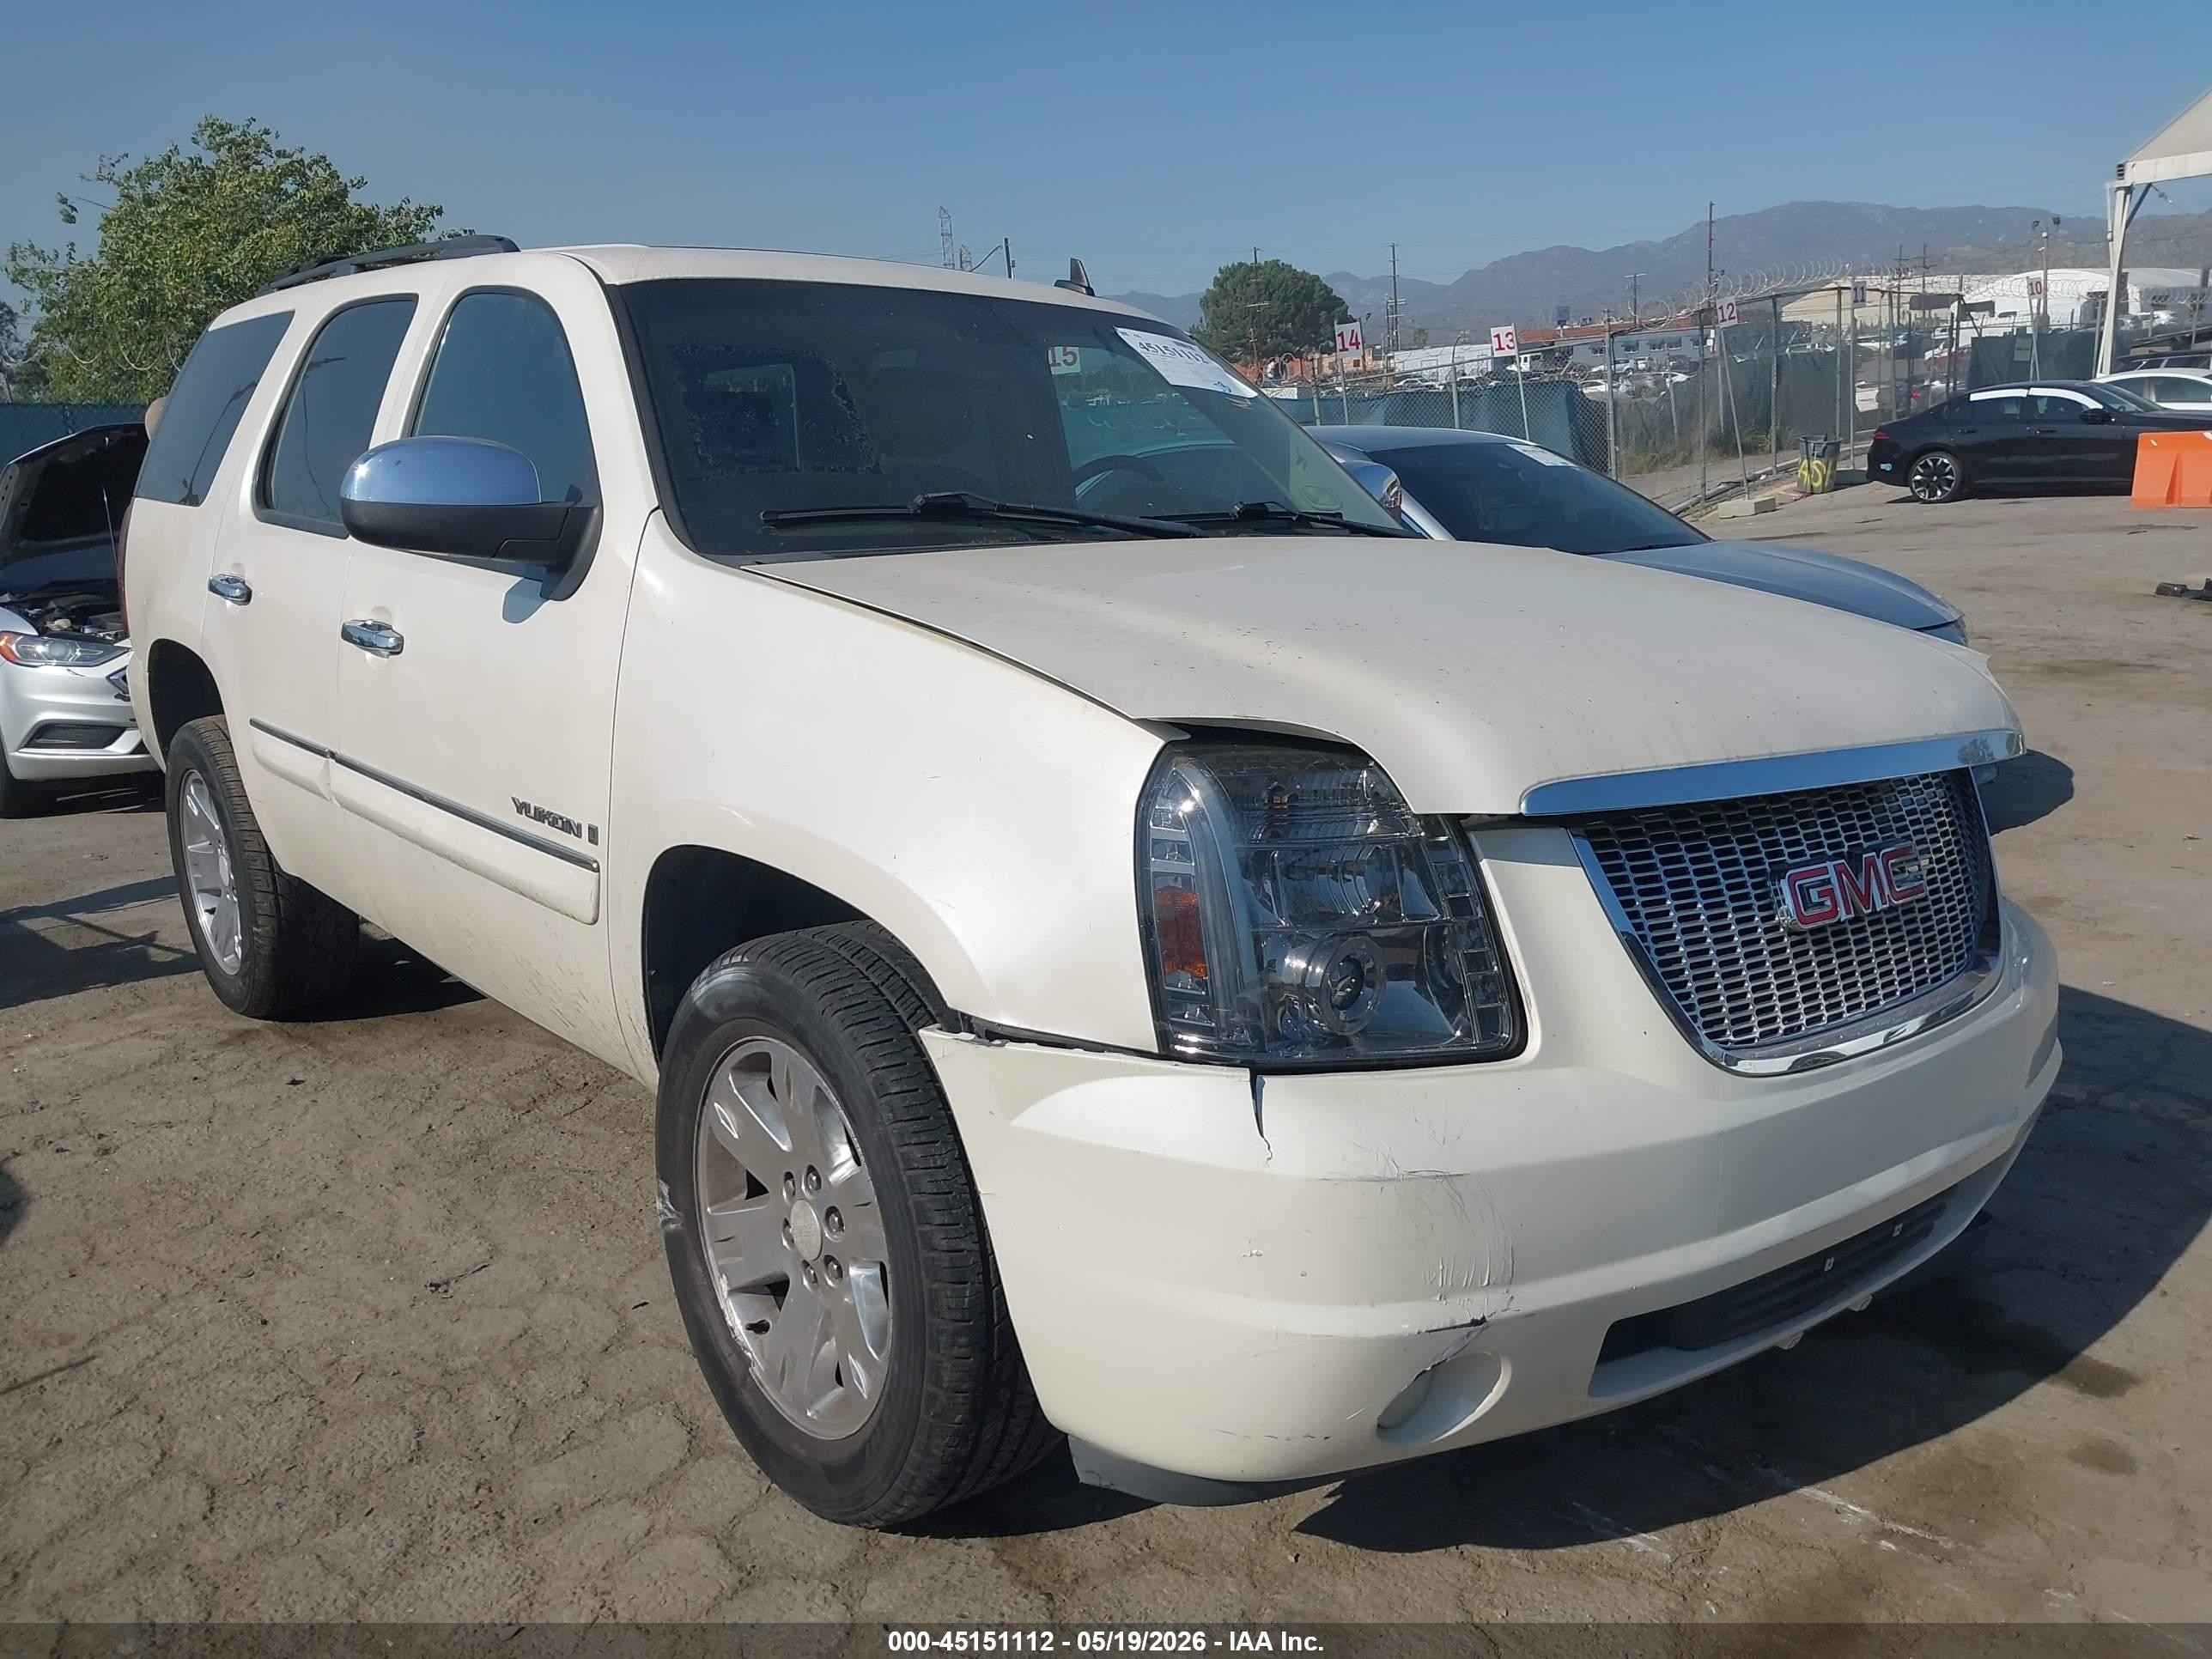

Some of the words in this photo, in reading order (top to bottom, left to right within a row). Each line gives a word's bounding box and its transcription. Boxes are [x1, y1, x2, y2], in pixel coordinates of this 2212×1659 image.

[1853, 287, 1865, 302] 11
[2028, 281, 2042, 295] 10
[1718, 302, 1735, 323] 12
[1337, 329, 1360, 352] 14
[1492, 331, 1515, 351] 13
[1049, 345, 1078, 367] 15
[1139, 341, 1209, 365] 45151112
[510, 795, 583, 840] YUKON
[1781, 844, 1927, 929] GMC
